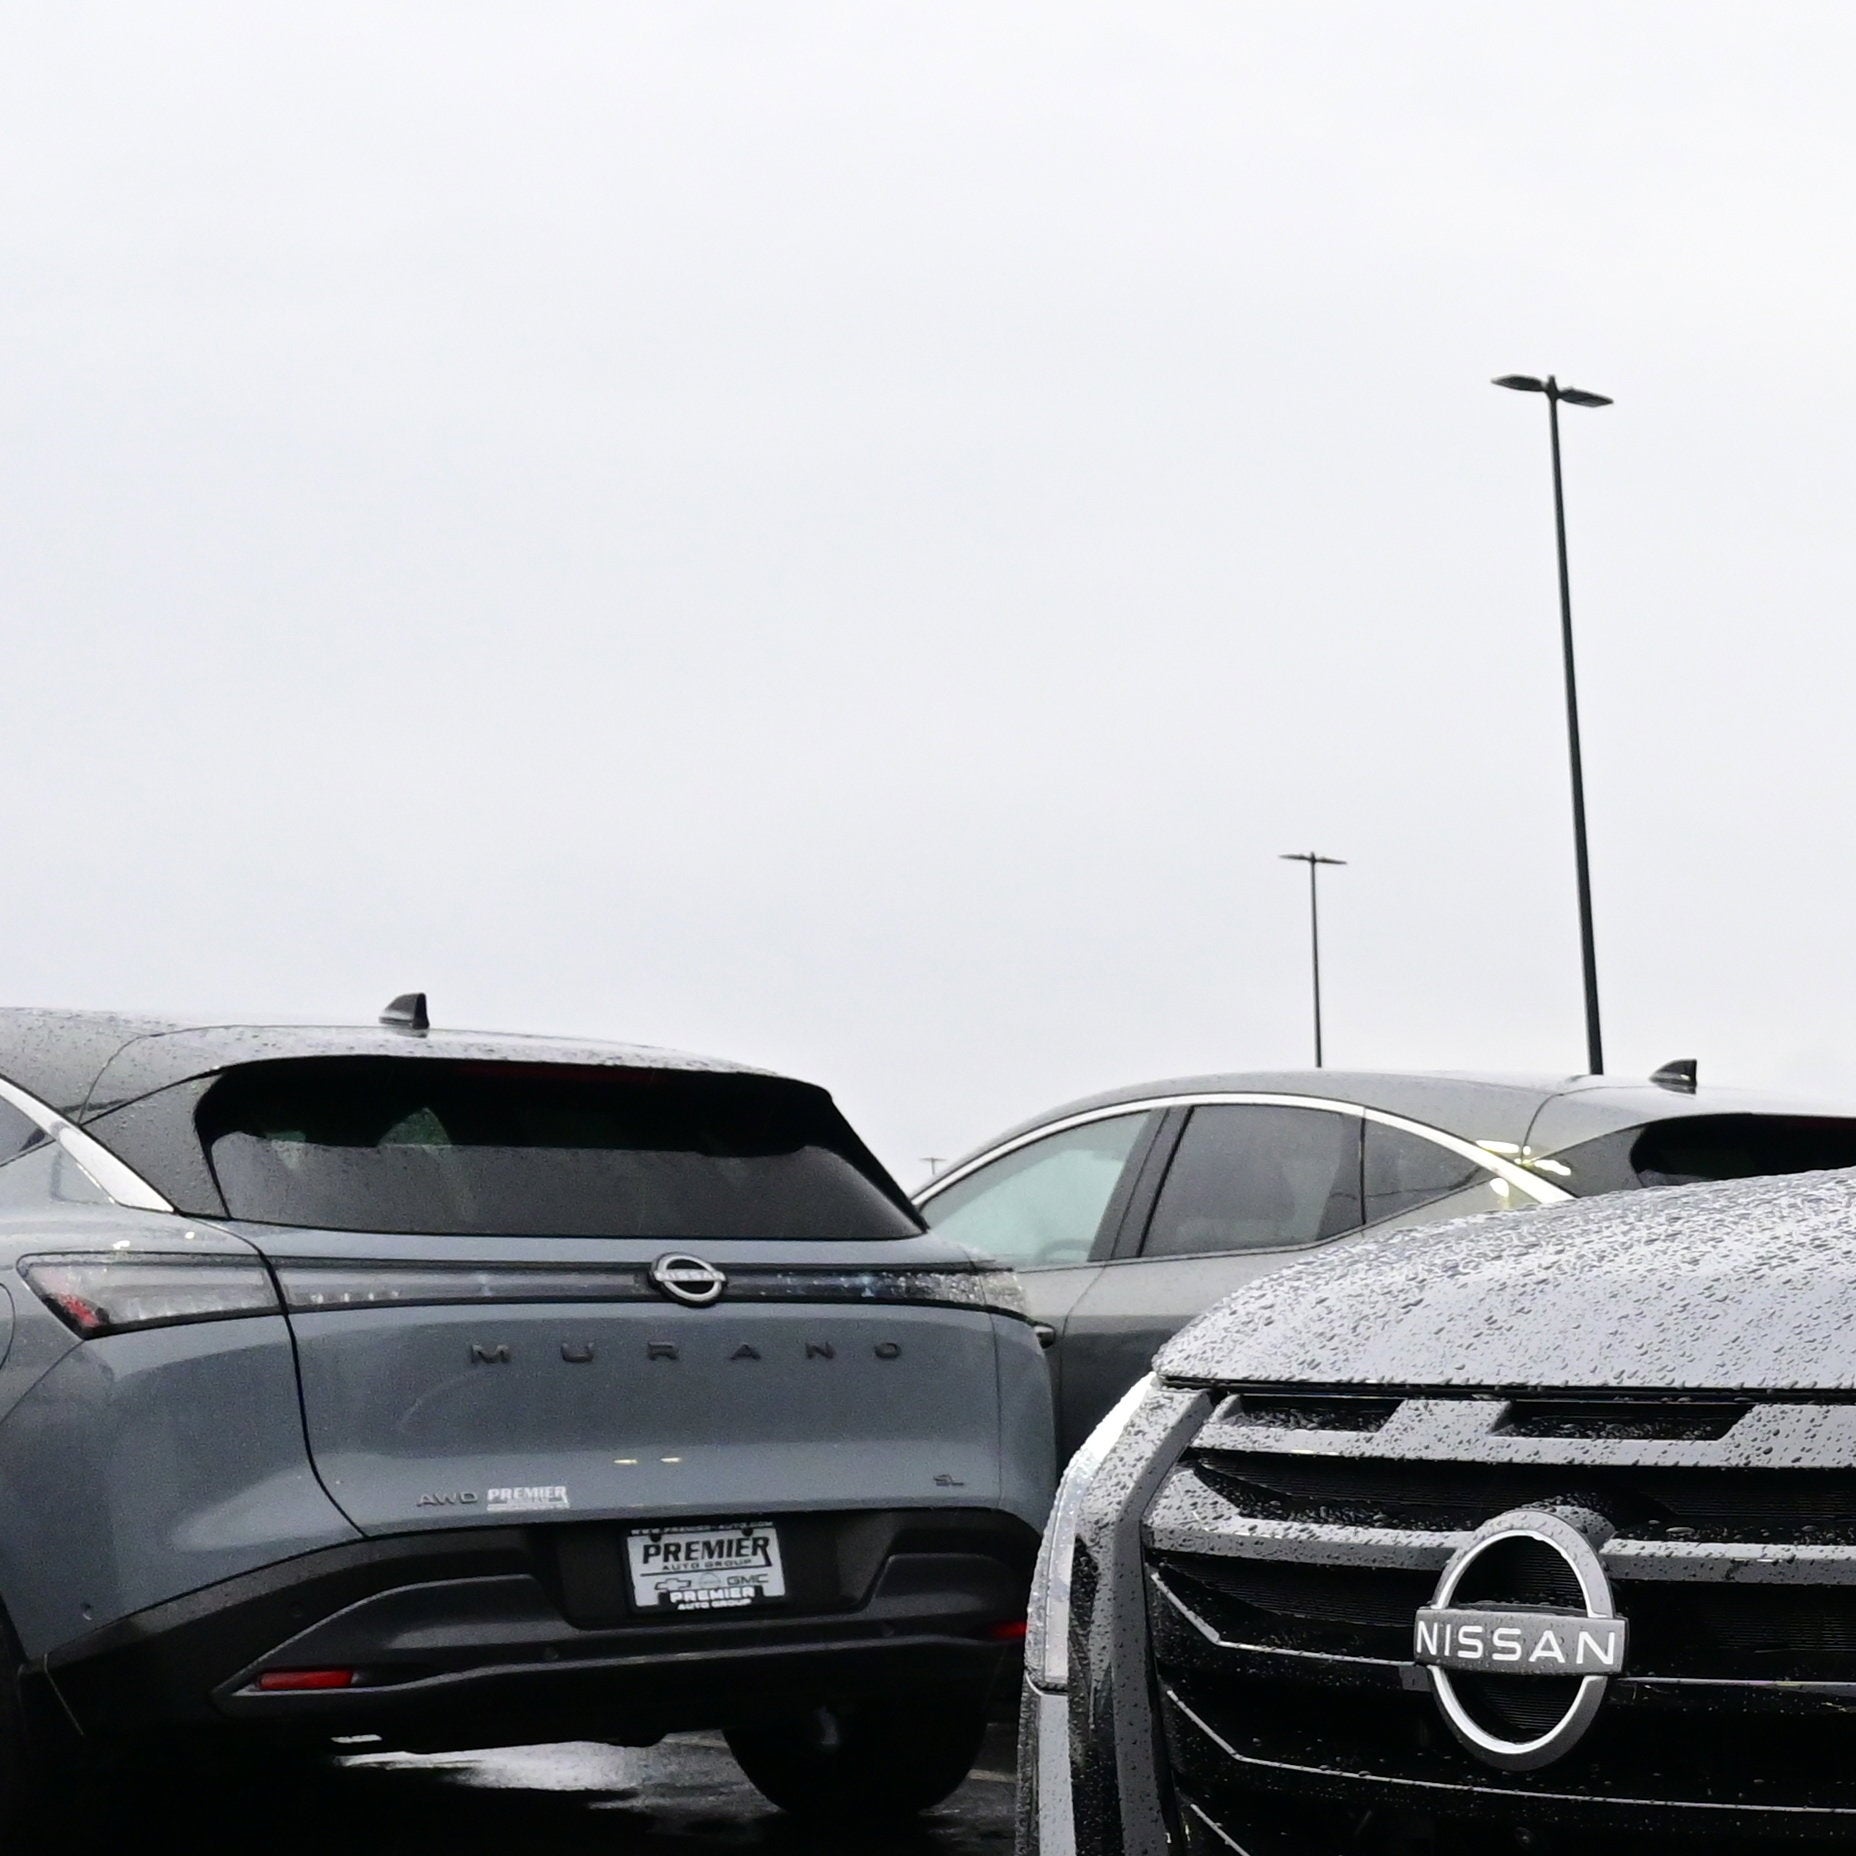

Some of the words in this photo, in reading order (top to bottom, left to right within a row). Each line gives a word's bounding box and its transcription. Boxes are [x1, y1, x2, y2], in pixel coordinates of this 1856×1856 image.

[469, 1341, 902, 1364] MURANO
[416, 1490, 479, 1508] AWD
[486, 1485, 570, 1504] PREMIER
[642, 1537, 772, 1565] PREMIER
[662, 1561, 700, 1571] AUTO
[704, 1558, 752, 1568] GROUP
[727, 1574, 769, 1585] GMC
[670, 1587, 755, 1603] PREMIER
[677, 1602, 710, 1611] AUTO
[712, 1598, 752, 1609] GROUP
[1416, 1621, 1615, 1665] NISSAN
